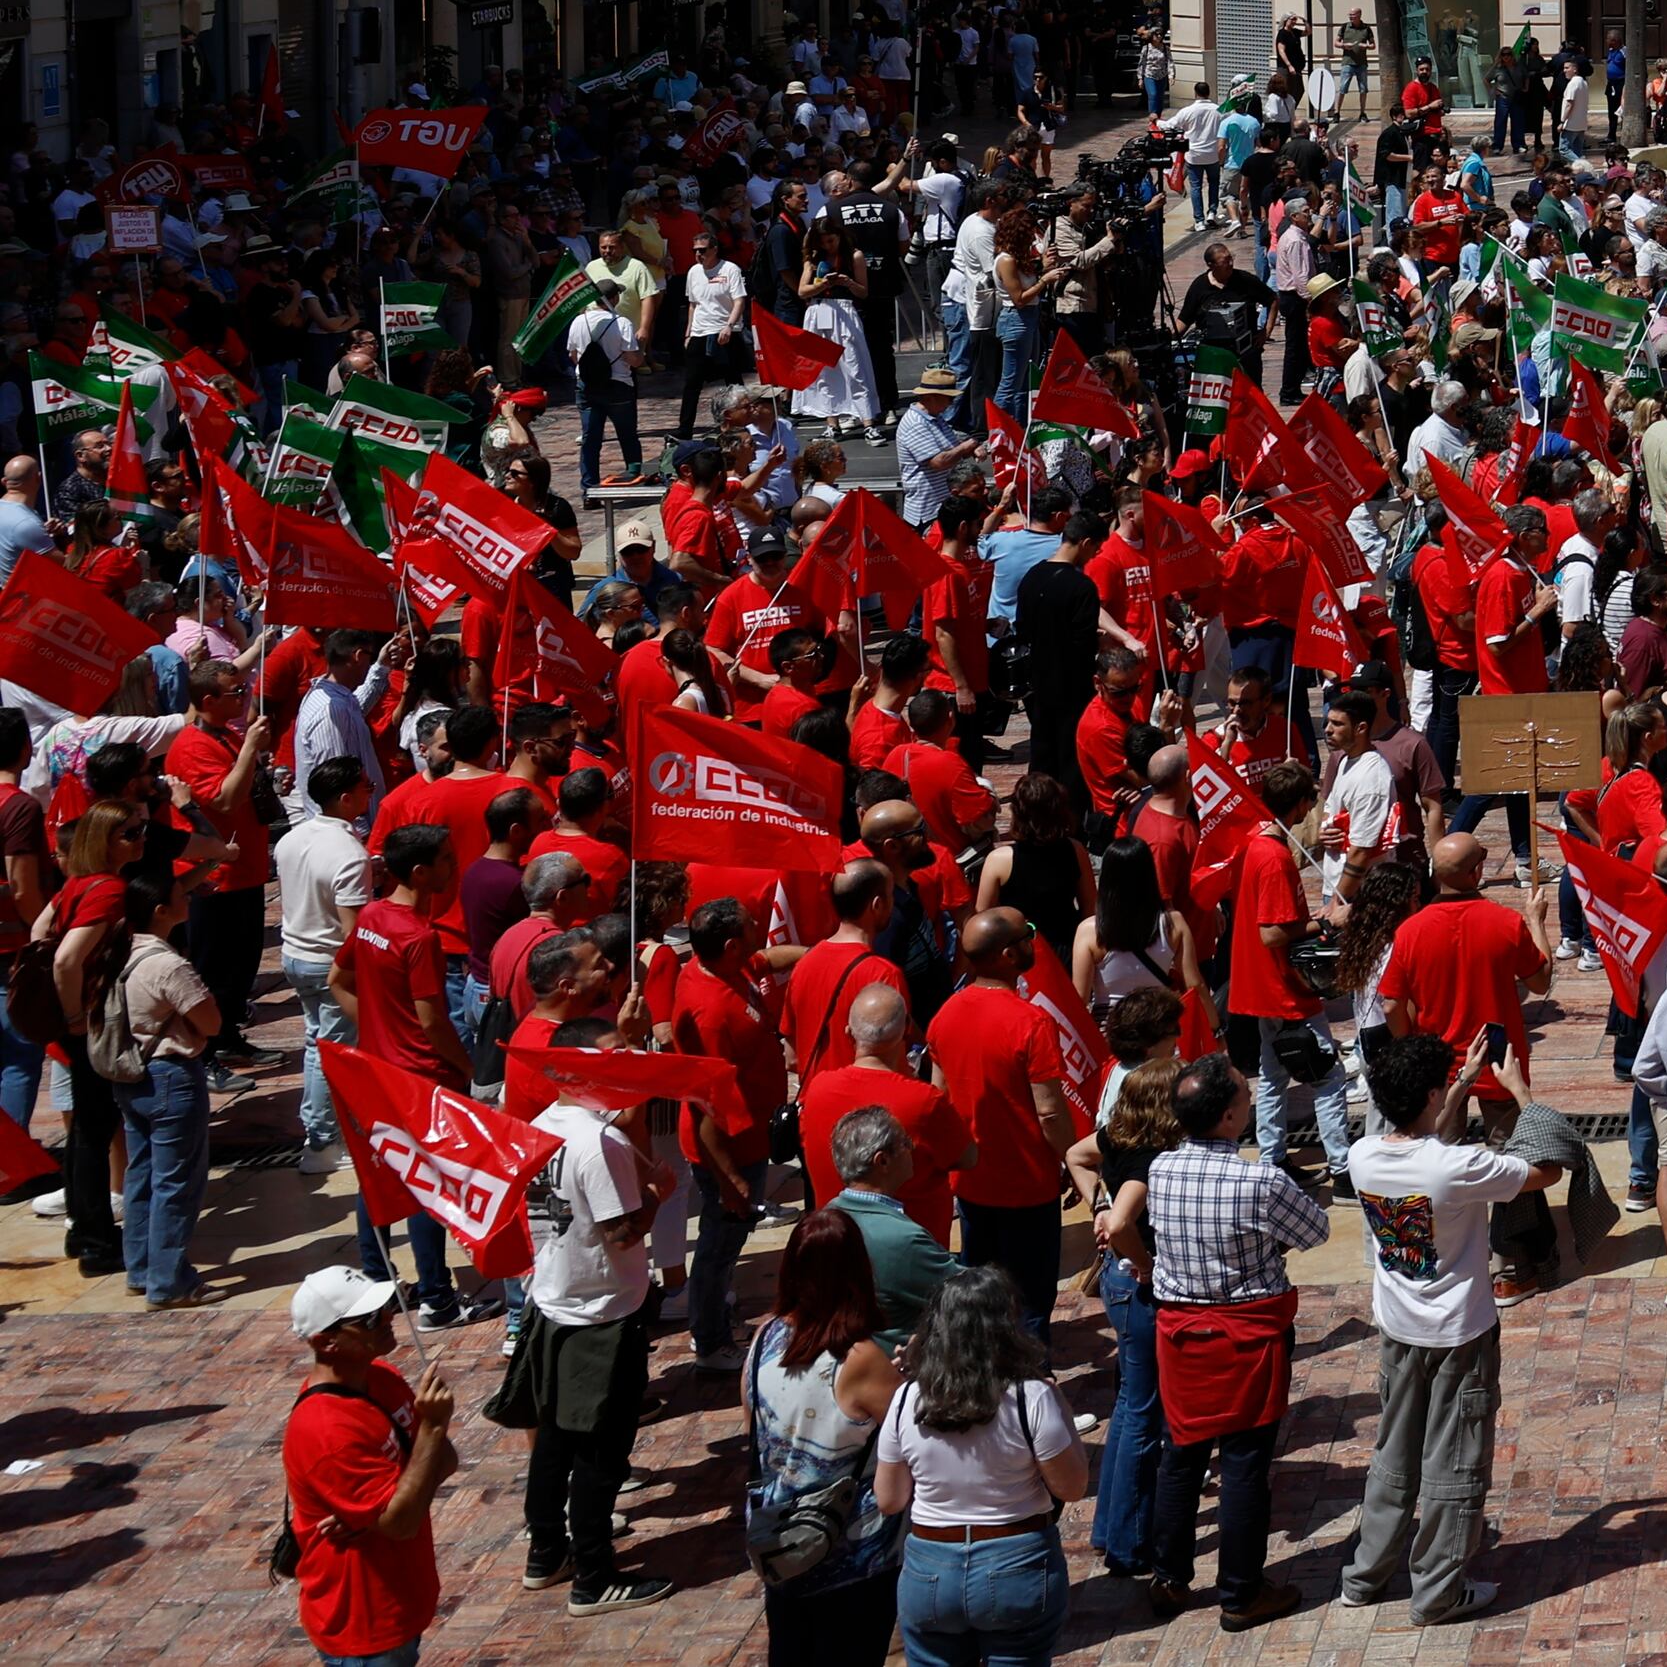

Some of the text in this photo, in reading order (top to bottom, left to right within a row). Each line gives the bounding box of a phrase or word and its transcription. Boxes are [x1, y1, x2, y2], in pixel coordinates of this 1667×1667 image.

[471, 4, 511, 25] STARBUCKS
[840, 203, 885, 219] PTV
[1555, 307, 1612, 340] CCOO
[47, 404, 107, 427] Málaga
[339, 408, 420, 445] CCOO
[1310, 441, 1365, 501] CCOO
[443, 511, 515, 568] CCOO
[54, 651, 111, 686] industria
[651, 803, 830, 836] federación de industria
[377, 1138, 493, 1225] CCOO
